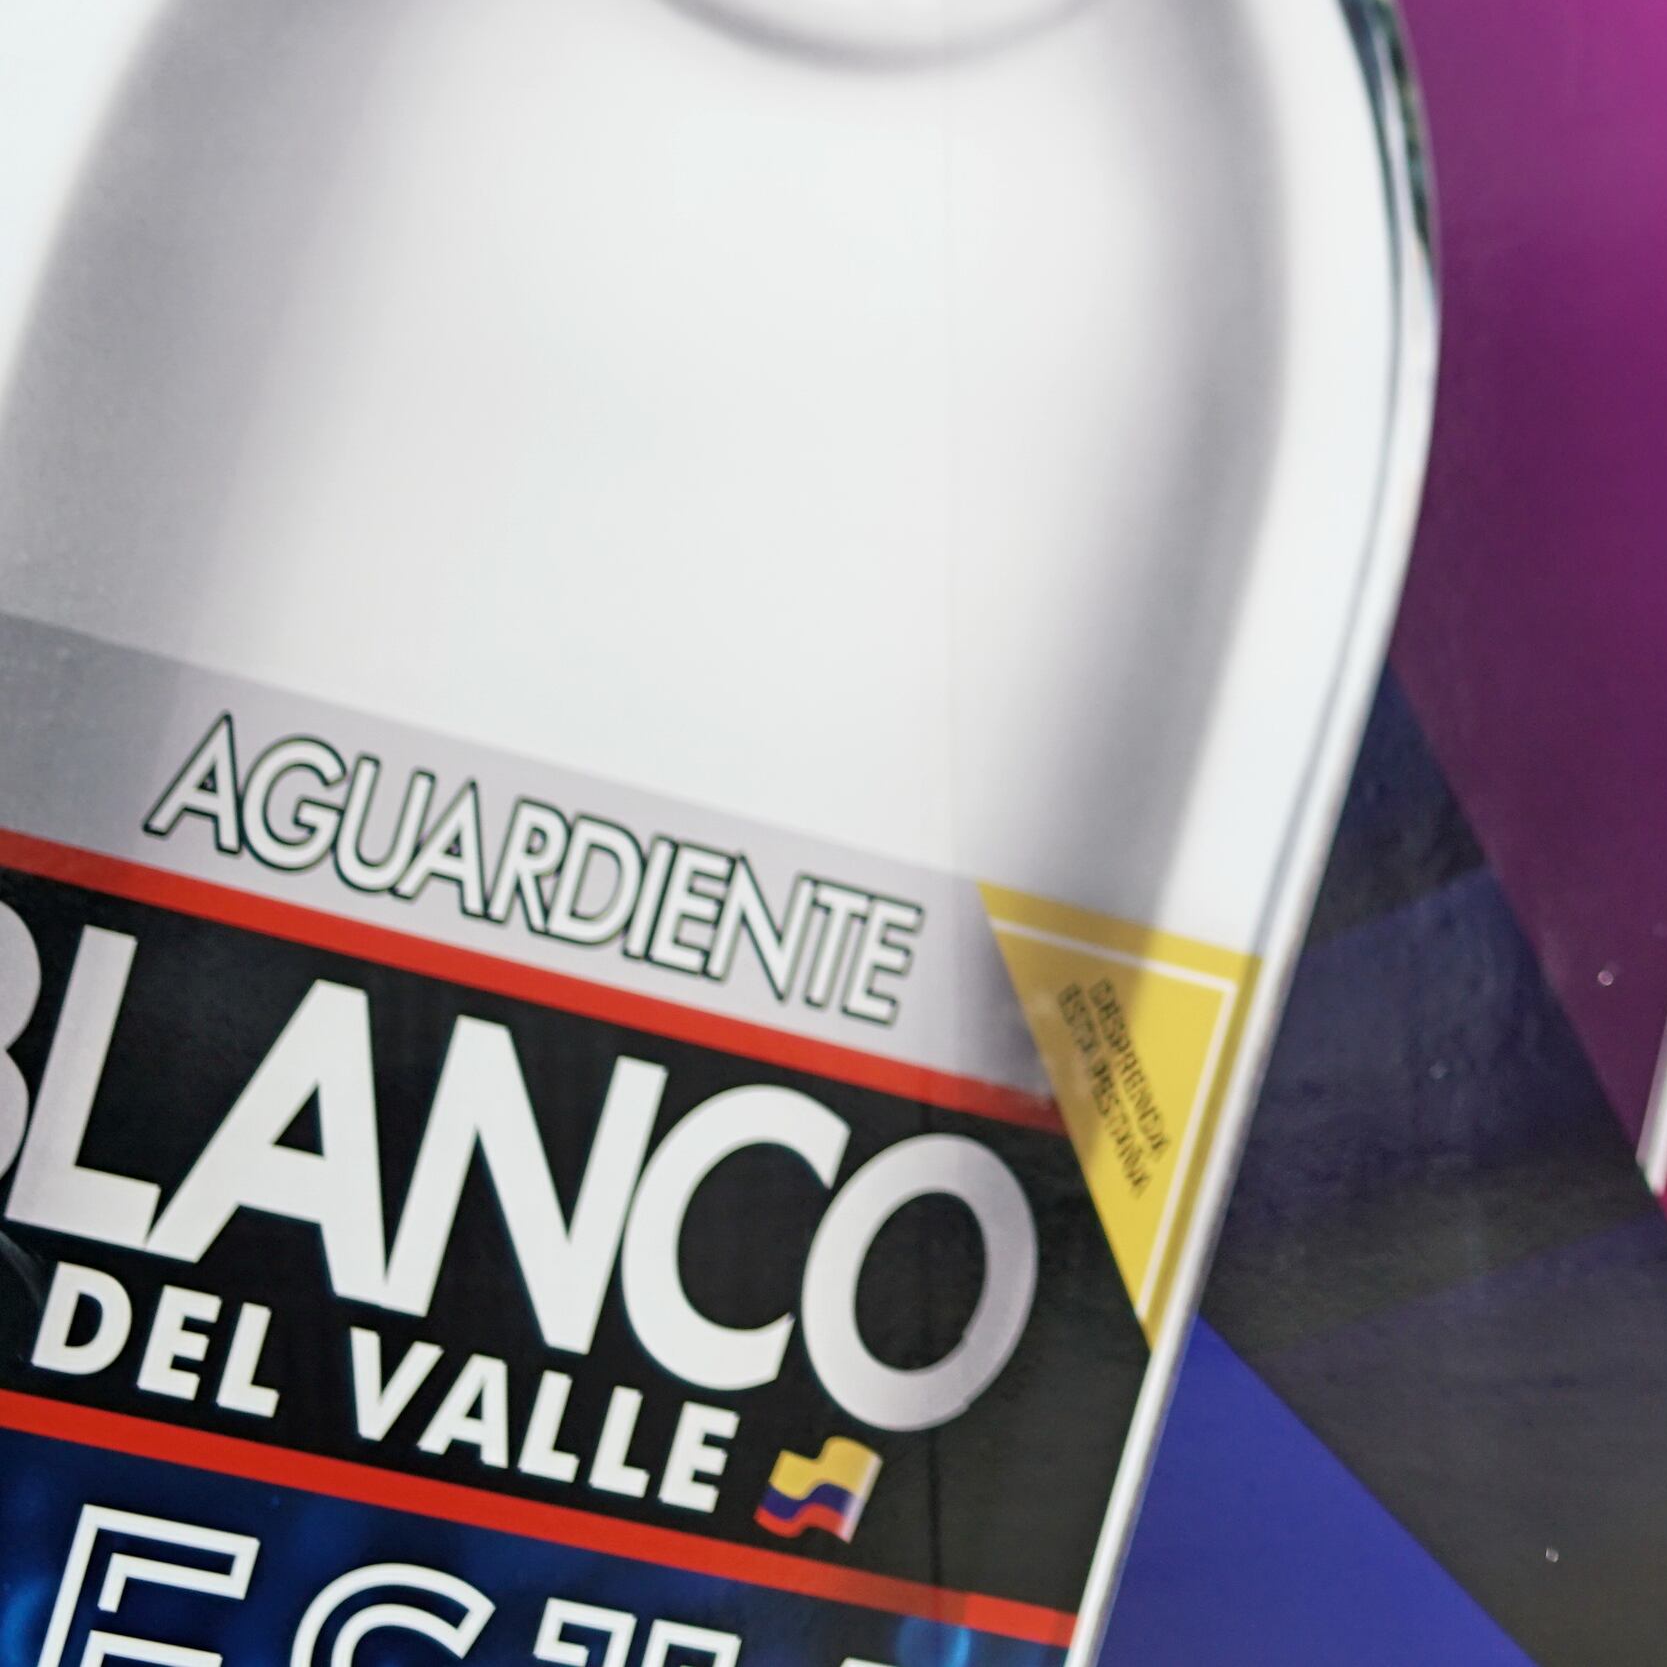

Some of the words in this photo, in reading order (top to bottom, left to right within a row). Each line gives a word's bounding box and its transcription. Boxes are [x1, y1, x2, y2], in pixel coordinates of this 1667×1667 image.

[143, 712, 925, 1027] AGUARDIENTE
[0, 892, 1039, 1433] LANCO
[32, 1259, 280, 1420] DEL
[350, 1327, 740, 1513] VALLE
